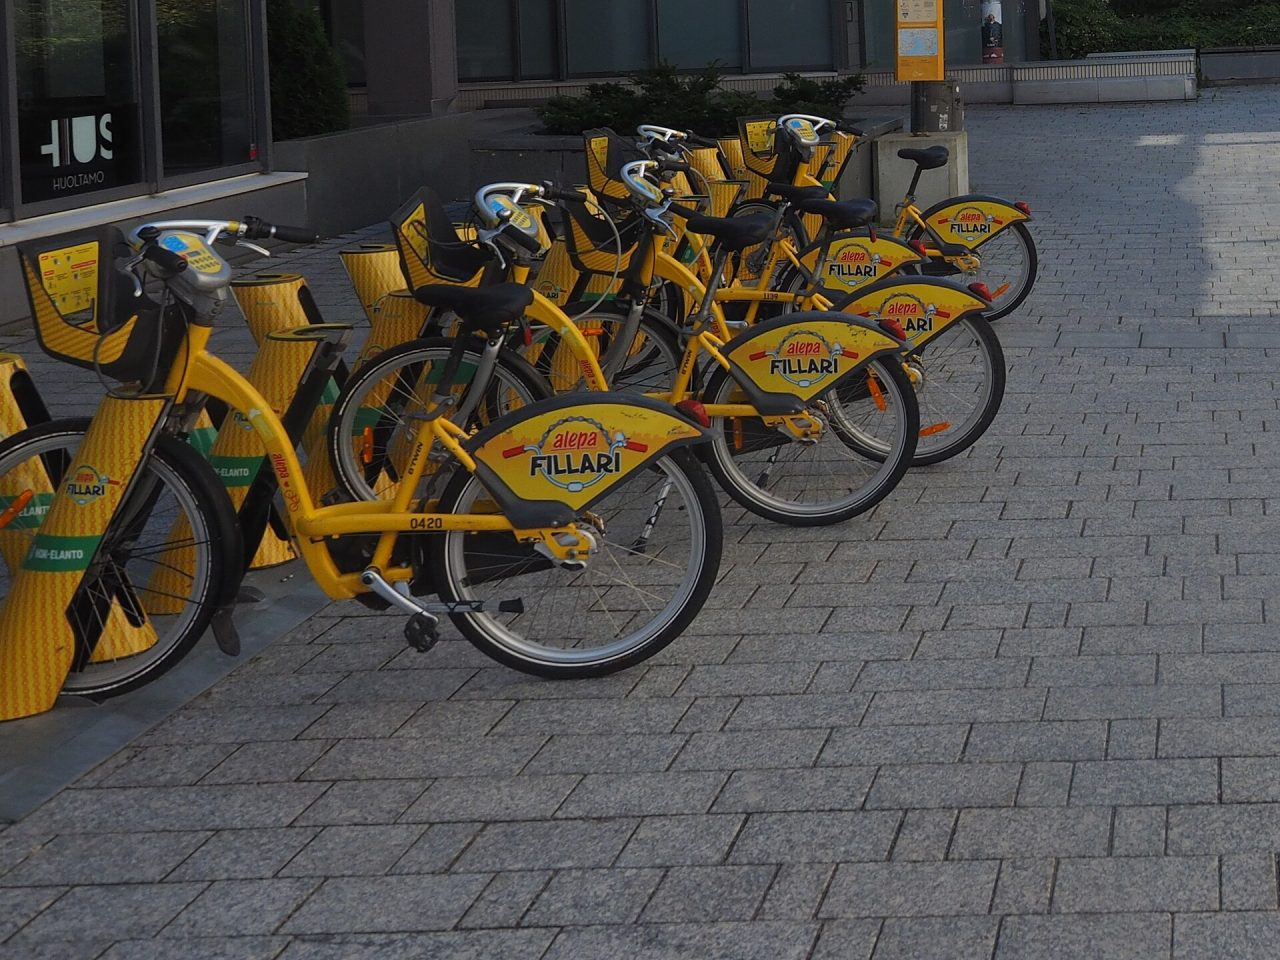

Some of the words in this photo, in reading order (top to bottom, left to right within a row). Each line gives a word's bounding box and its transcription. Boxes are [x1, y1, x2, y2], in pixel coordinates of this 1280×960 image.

[41, 113, 113, 167] HUS
[53, 171, 104, 190] HUOLTAMO
[960, 212, 981, 222] alepa
[950, 223, 991, 233] FILLARI
[840, 251, 865, 262] alepa
[828, 264, 877, 277] FILLARI
[888, 302, 917, 315] alepa
[787, 340, 821, 356] alepa
[770, 358, 838, 375] FILLARI
[553, 430, 598, 449] alepa
[530, 453, 621, 476] FILLARI
[66, 483, 105, 496] FILLARI
[410, 517, 442, 529] 0420
